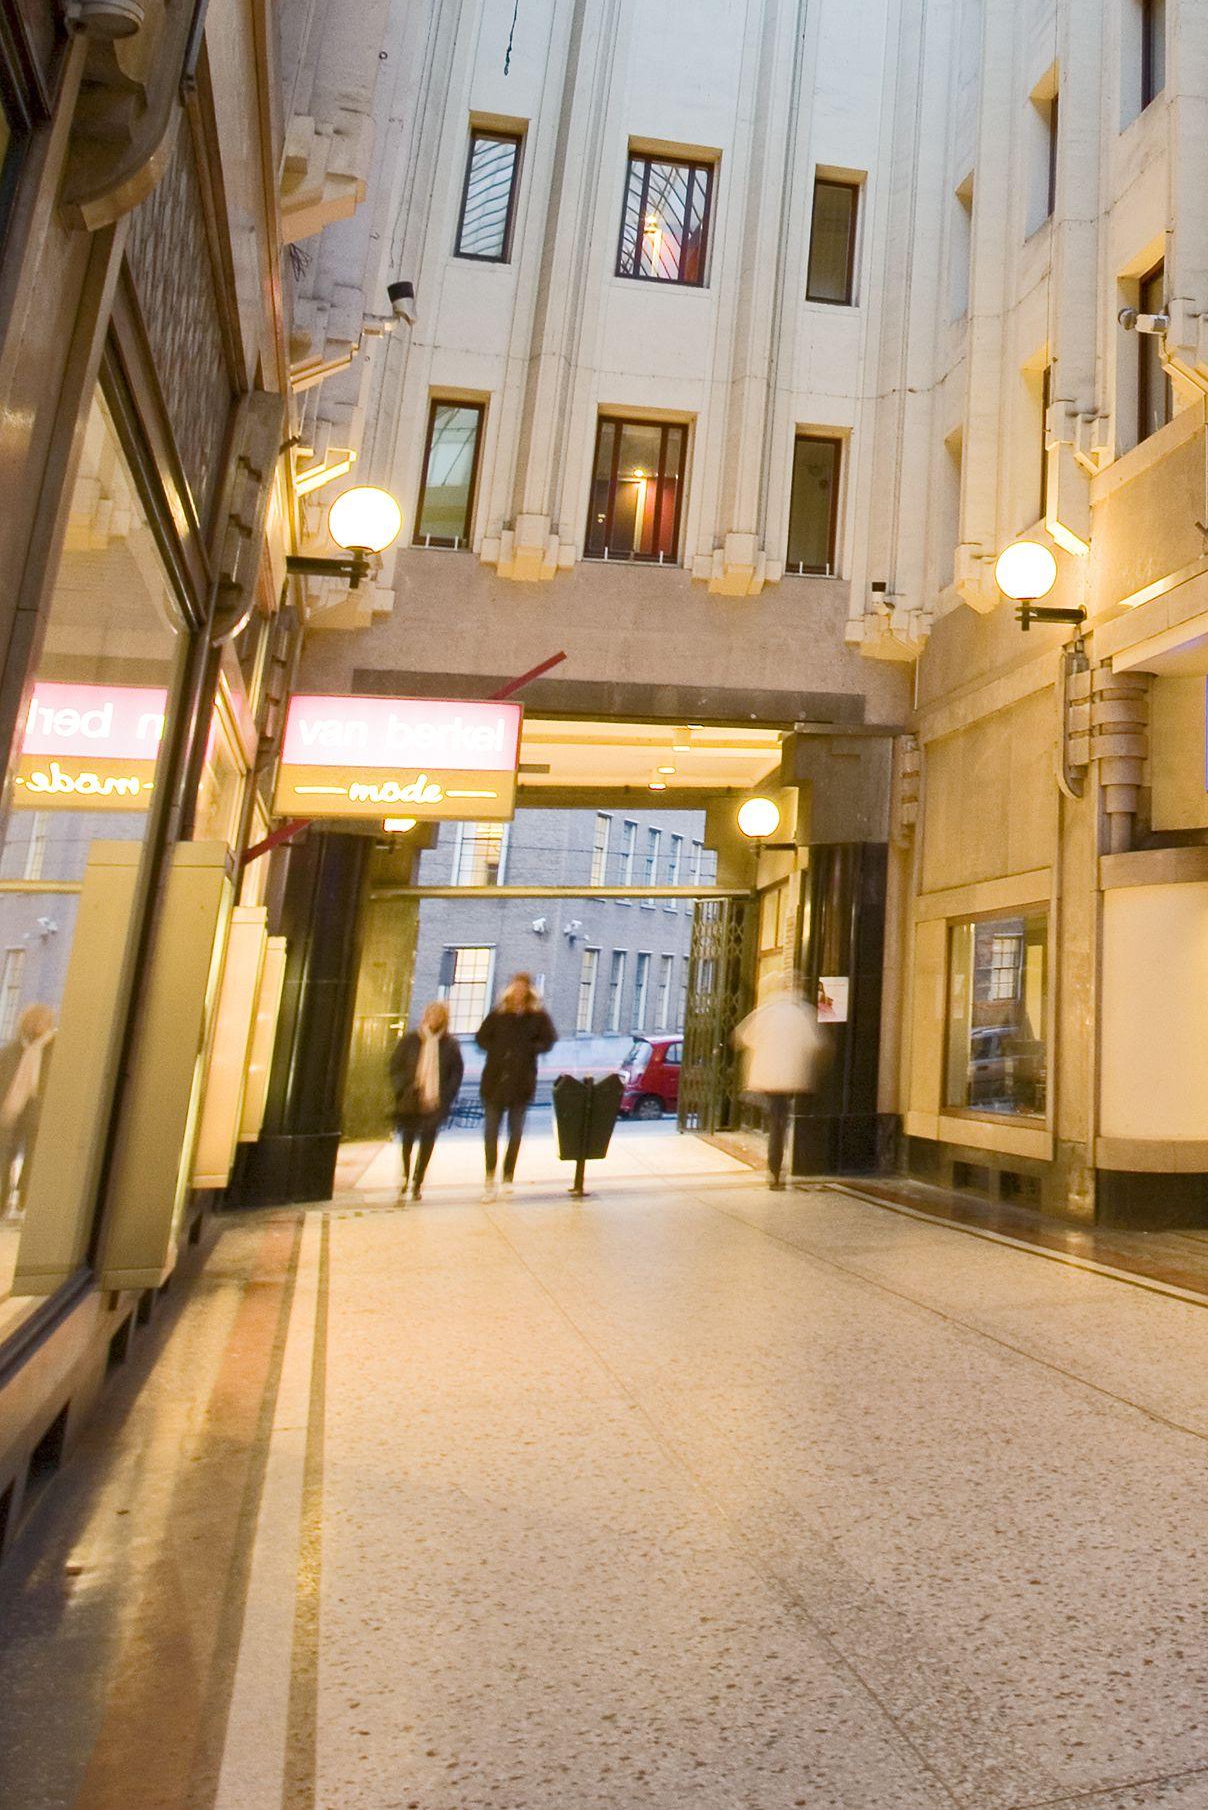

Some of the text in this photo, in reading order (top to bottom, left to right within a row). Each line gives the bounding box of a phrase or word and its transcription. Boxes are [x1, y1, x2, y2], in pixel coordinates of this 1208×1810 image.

[299, 714, 506, 753] van berkel
[348, 773, 444, 804] mode
